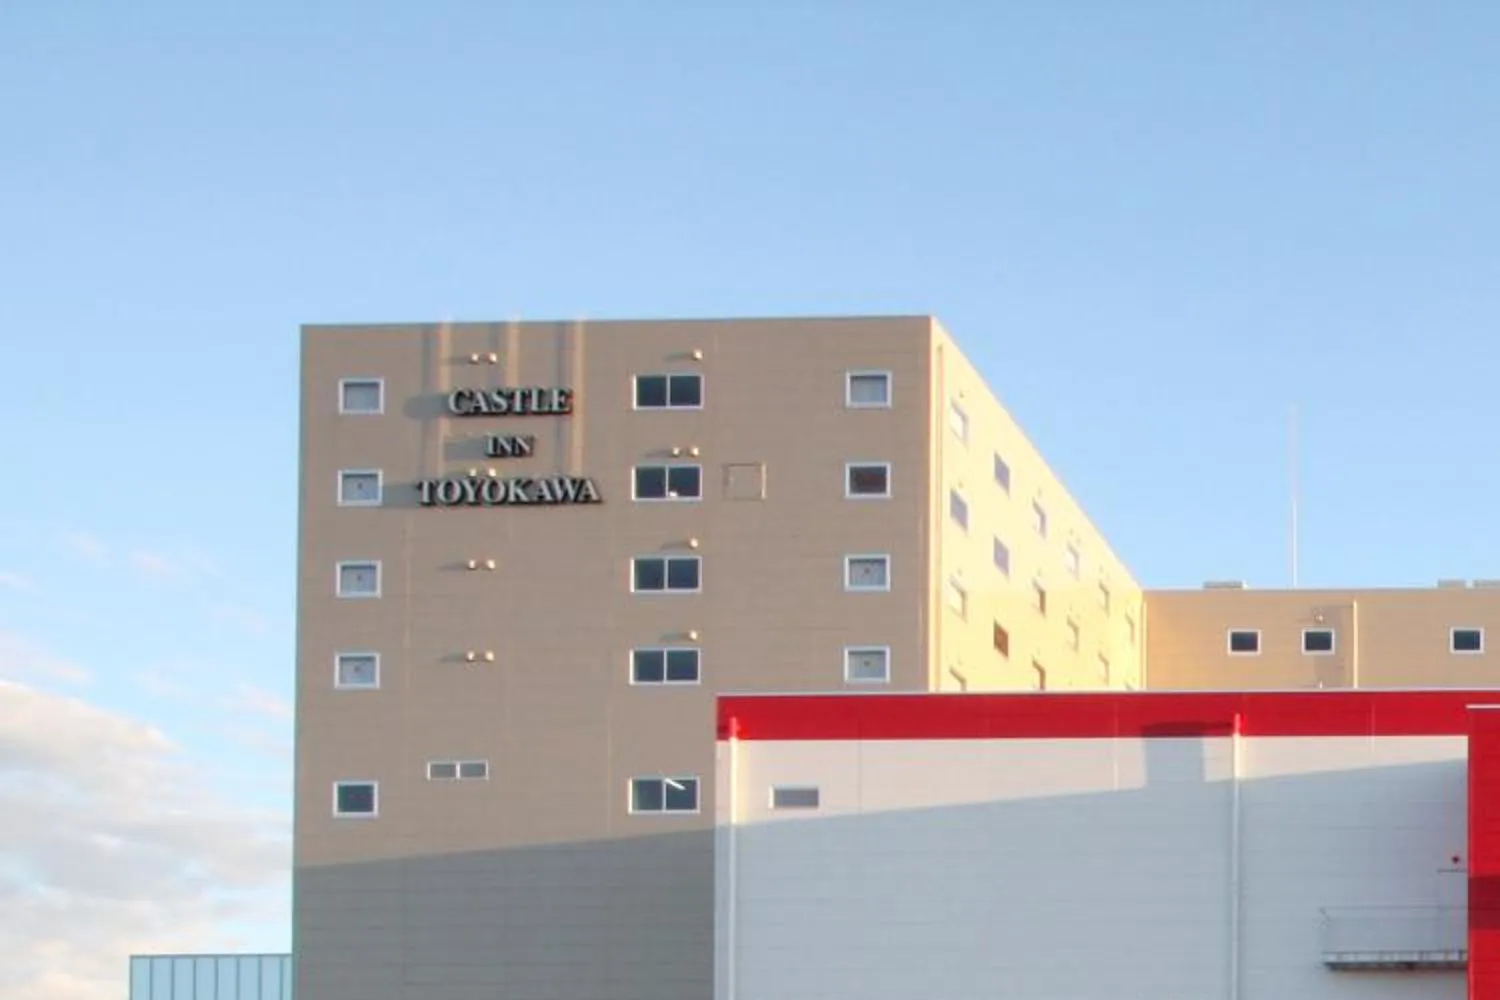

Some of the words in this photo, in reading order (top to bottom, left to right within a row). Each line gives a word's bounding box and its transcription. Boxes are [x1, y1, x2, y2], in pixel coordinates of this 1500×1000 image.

[449, 388, 573, 416] CASTLE
[485, 435, 535, 457] INN
[418, 478, 602, 505] TOYOKAWA
